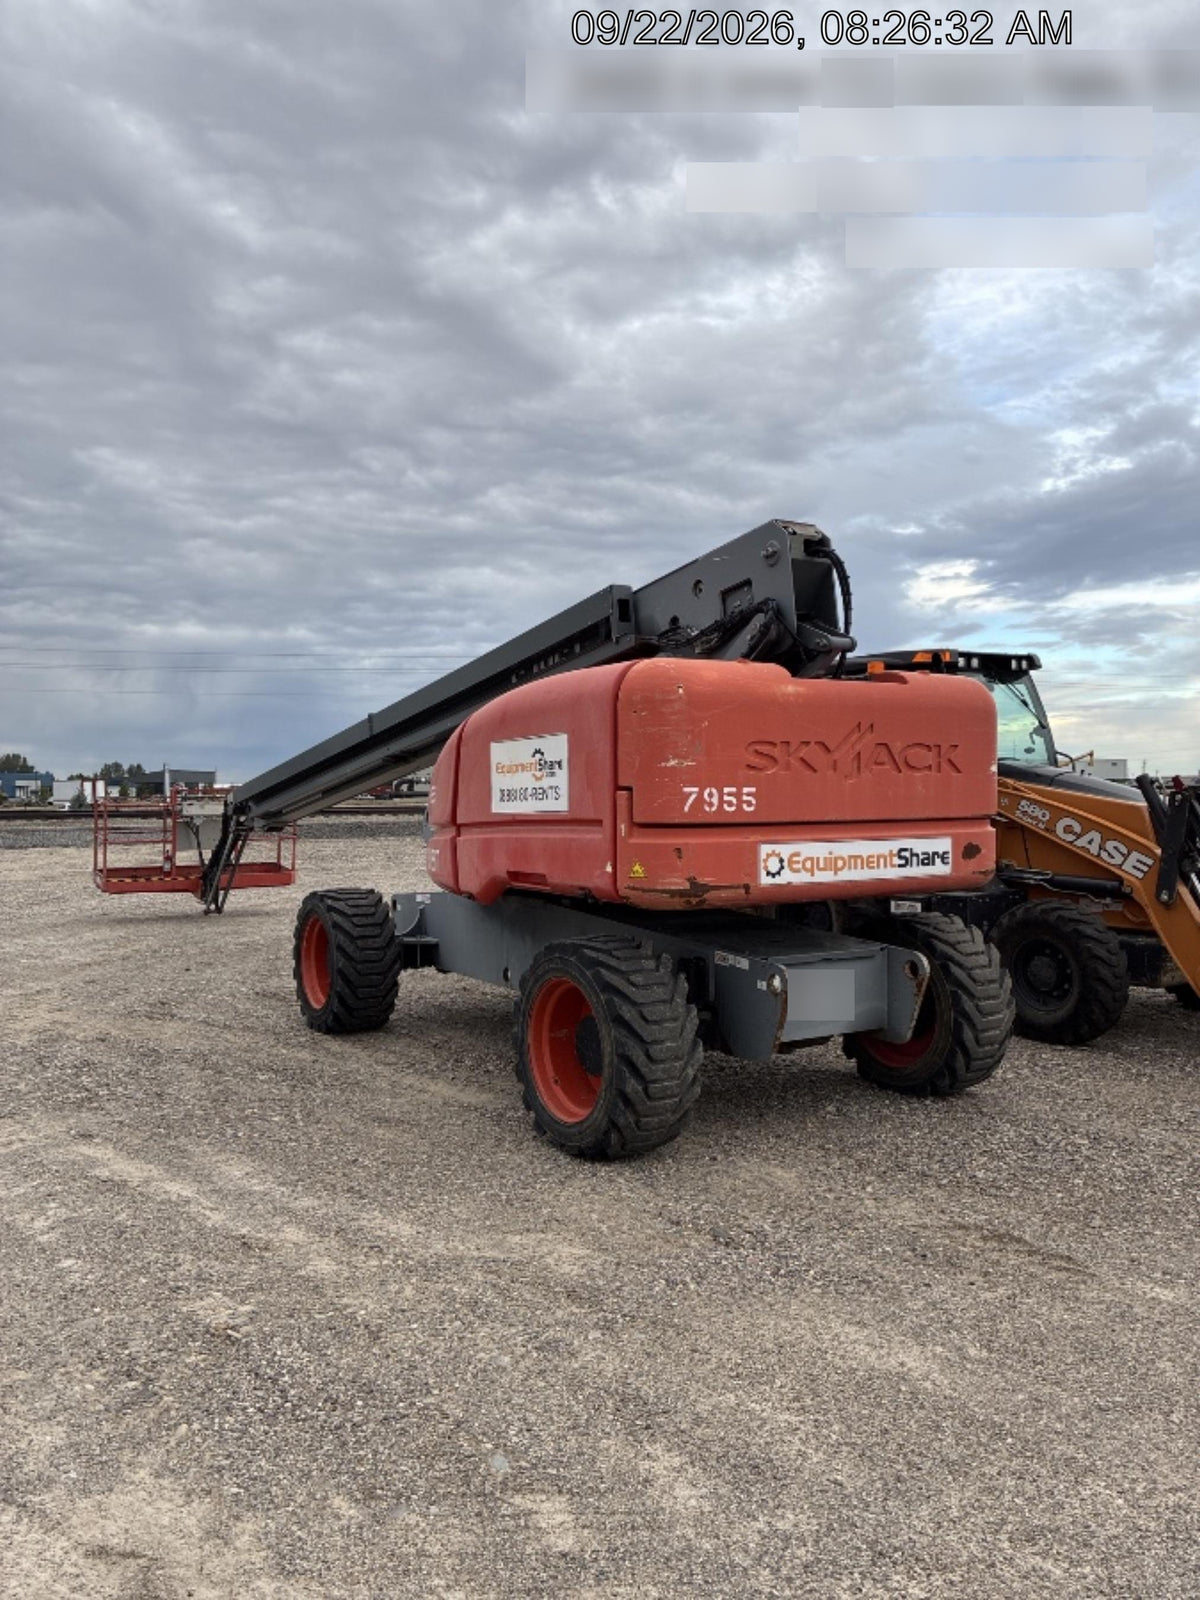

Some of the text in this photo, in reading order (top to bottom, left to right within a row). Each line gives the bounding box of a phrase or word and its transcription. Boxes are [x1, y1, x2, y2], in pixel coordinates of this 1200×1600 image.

[745, 721, 963, 783] SKYJACK
[682, 786, 757, 812] 7955
[1018, 800, 1050, 821] 580
[786, 847, 951, 877] EquipmentShare
[1055, 817, 1155, 879] CASE
